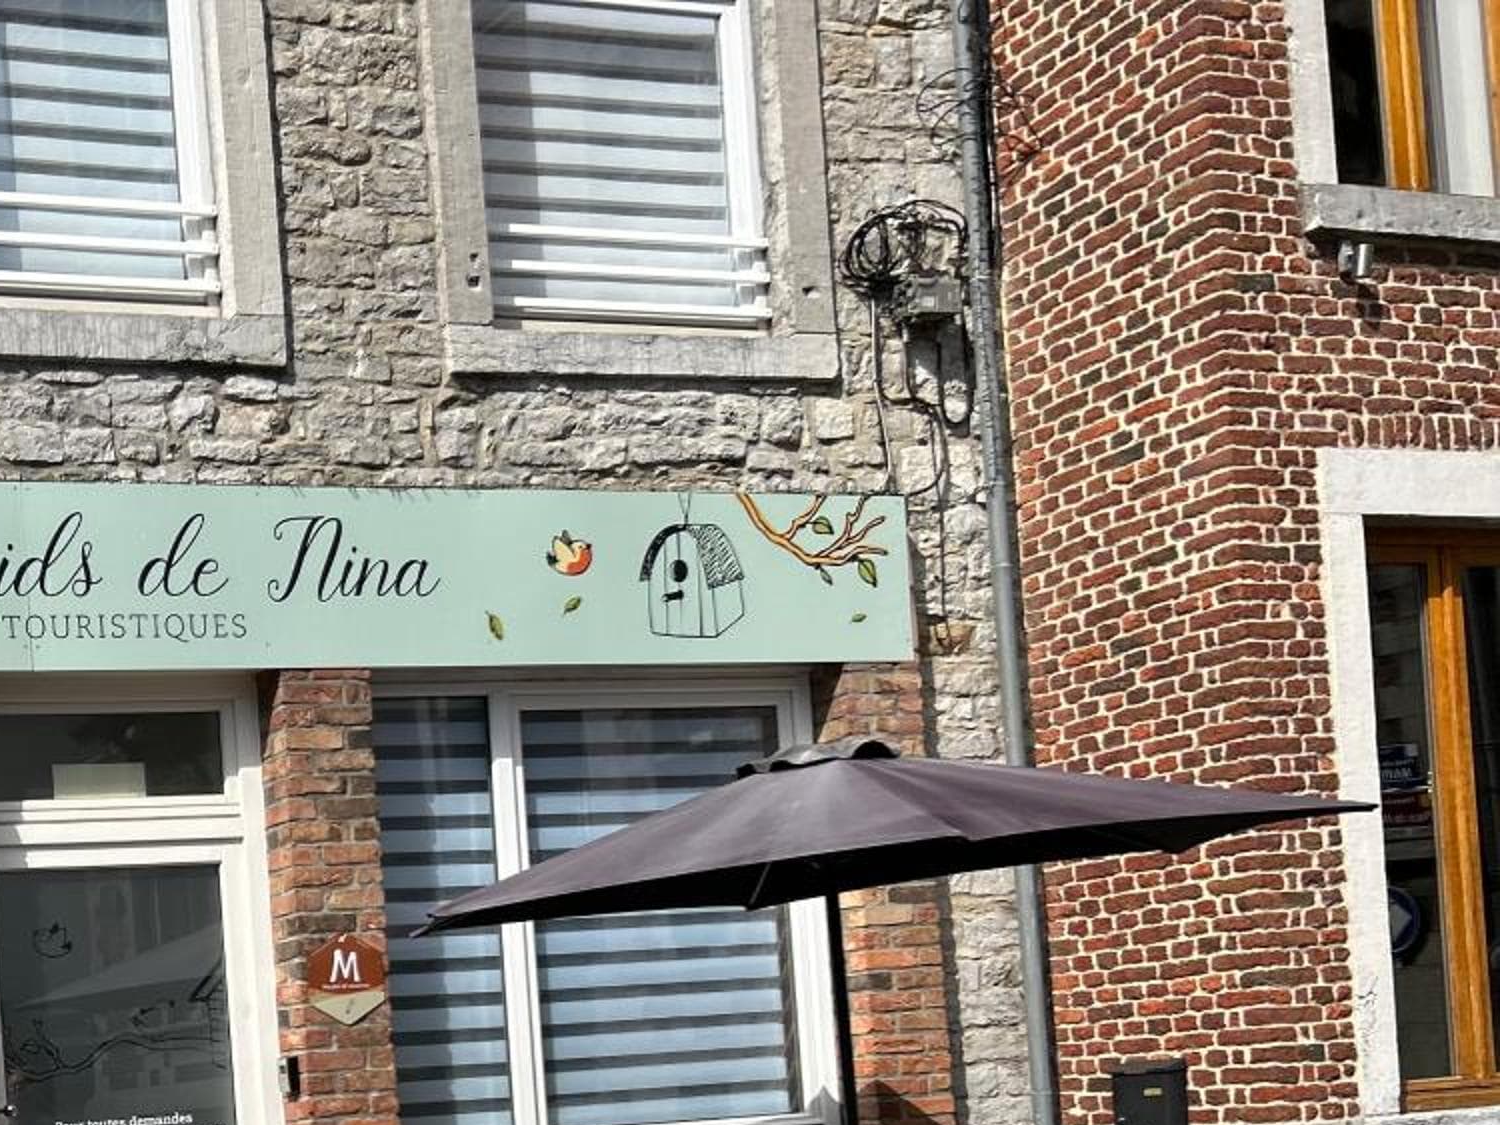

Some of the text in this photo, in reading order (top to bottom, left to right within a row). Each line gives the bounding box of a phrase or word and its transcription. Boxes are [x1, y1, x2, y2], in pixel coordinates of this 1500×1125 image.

[138, 513, 230, 597] de
[267, 515, 442, 602] Nina
[1, 613, 248, 643] TOURISTIQUES
[328, 948, 361, 983] M
